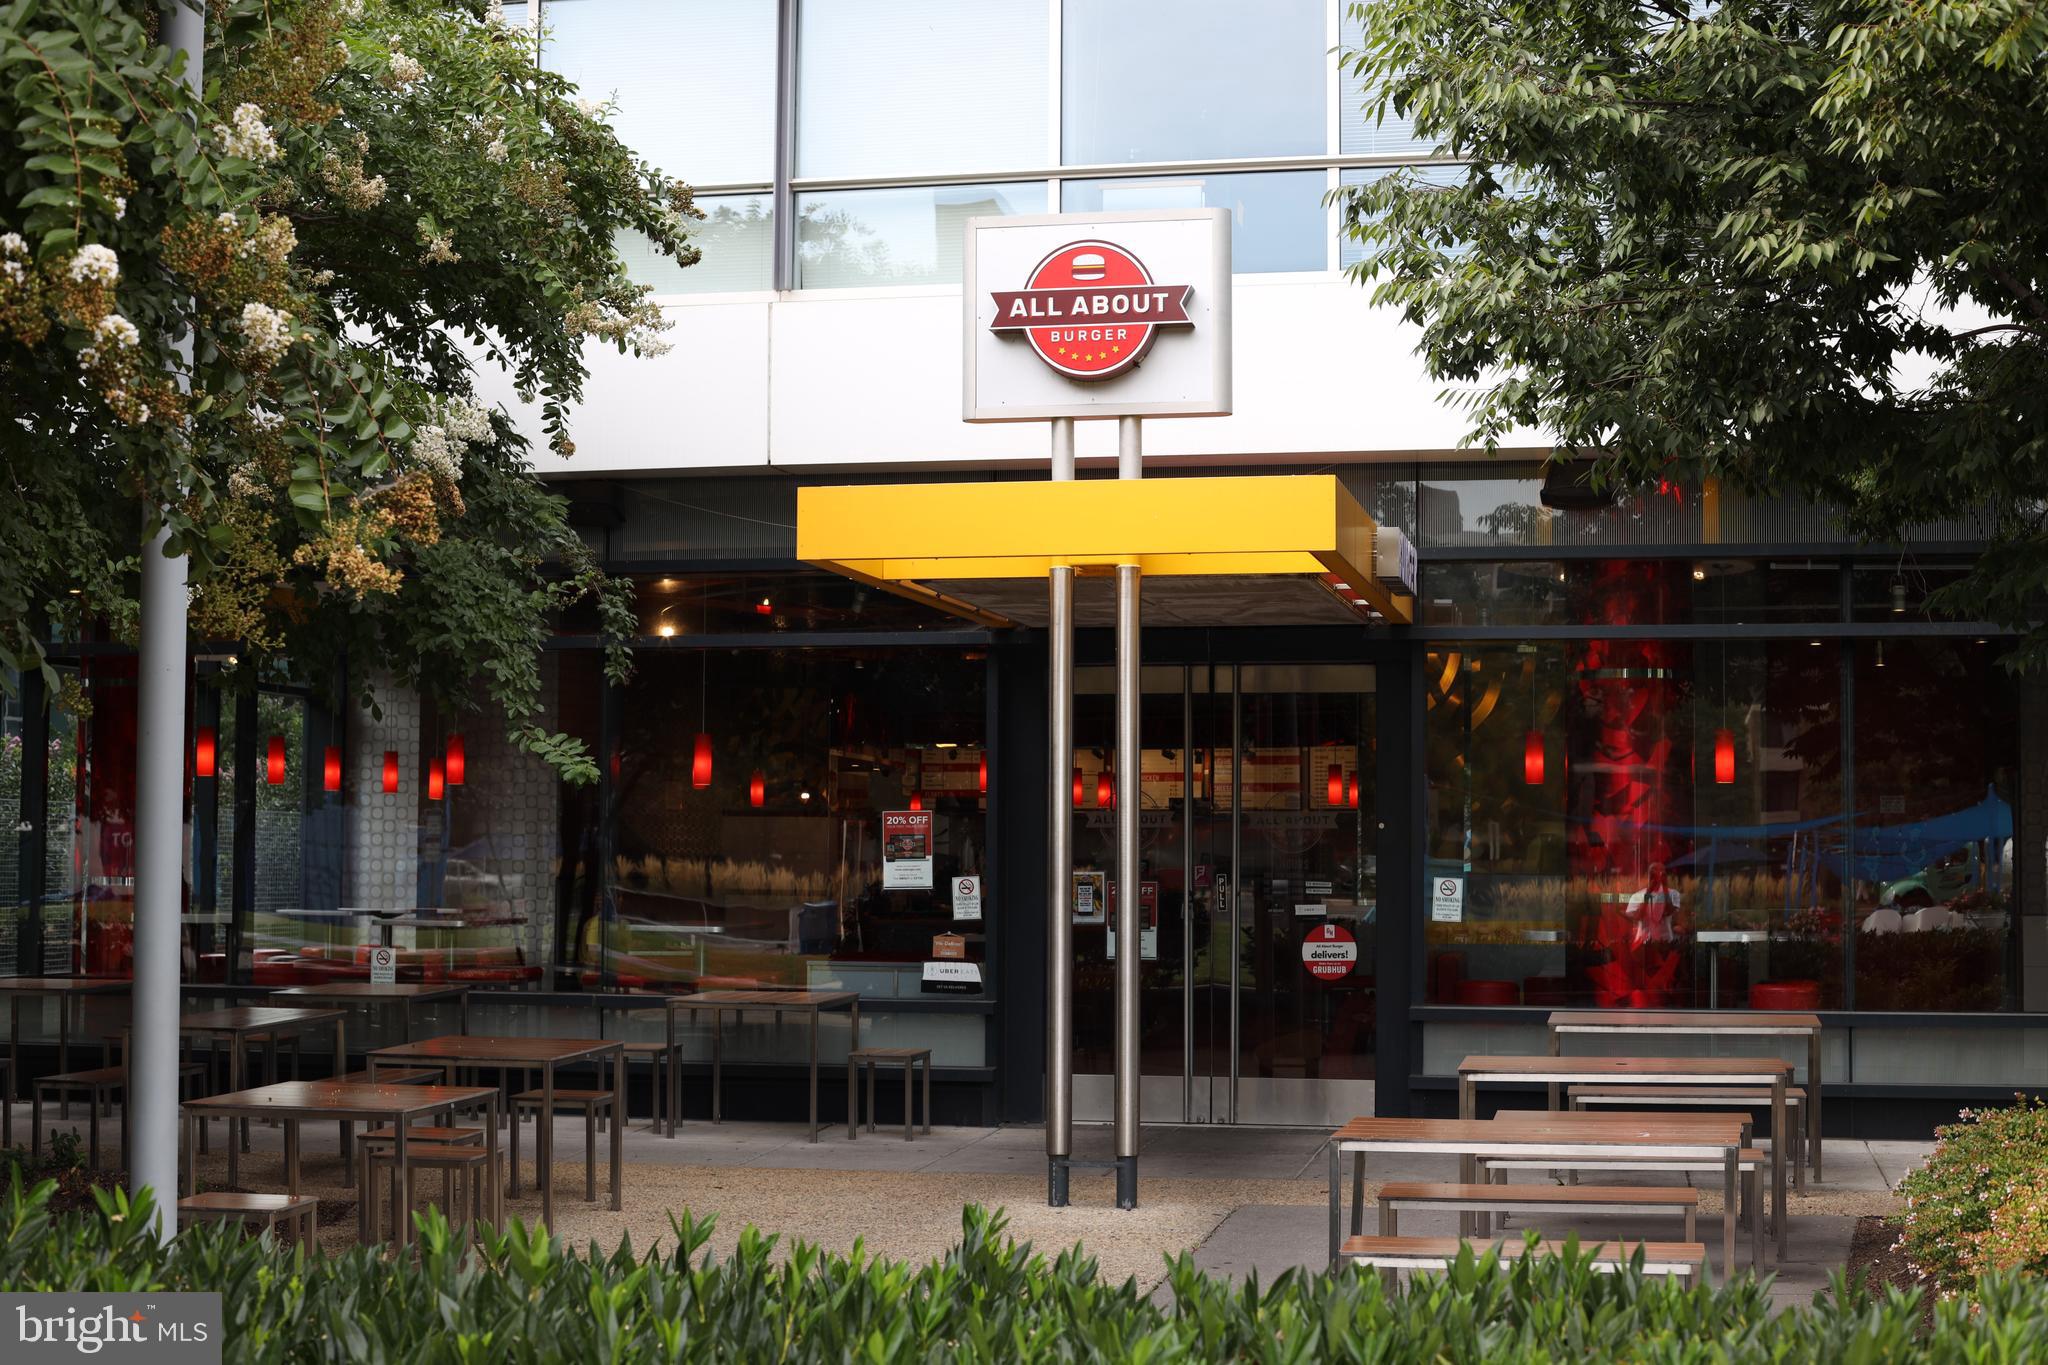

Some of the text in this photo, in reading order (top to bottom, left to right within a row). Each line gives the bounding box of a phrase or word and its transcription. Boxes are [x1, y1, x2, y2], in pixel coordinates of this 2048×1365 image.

[1009, 292, 1169, 318] ALL ABOUT
[1050, 329, 1128, 342] BURGER
[886, 815, 929, 825] 20% OFF
[1311, 950, 1349, 959] delivers!
[1312, 965, 1347, 974] GRUBHUB
